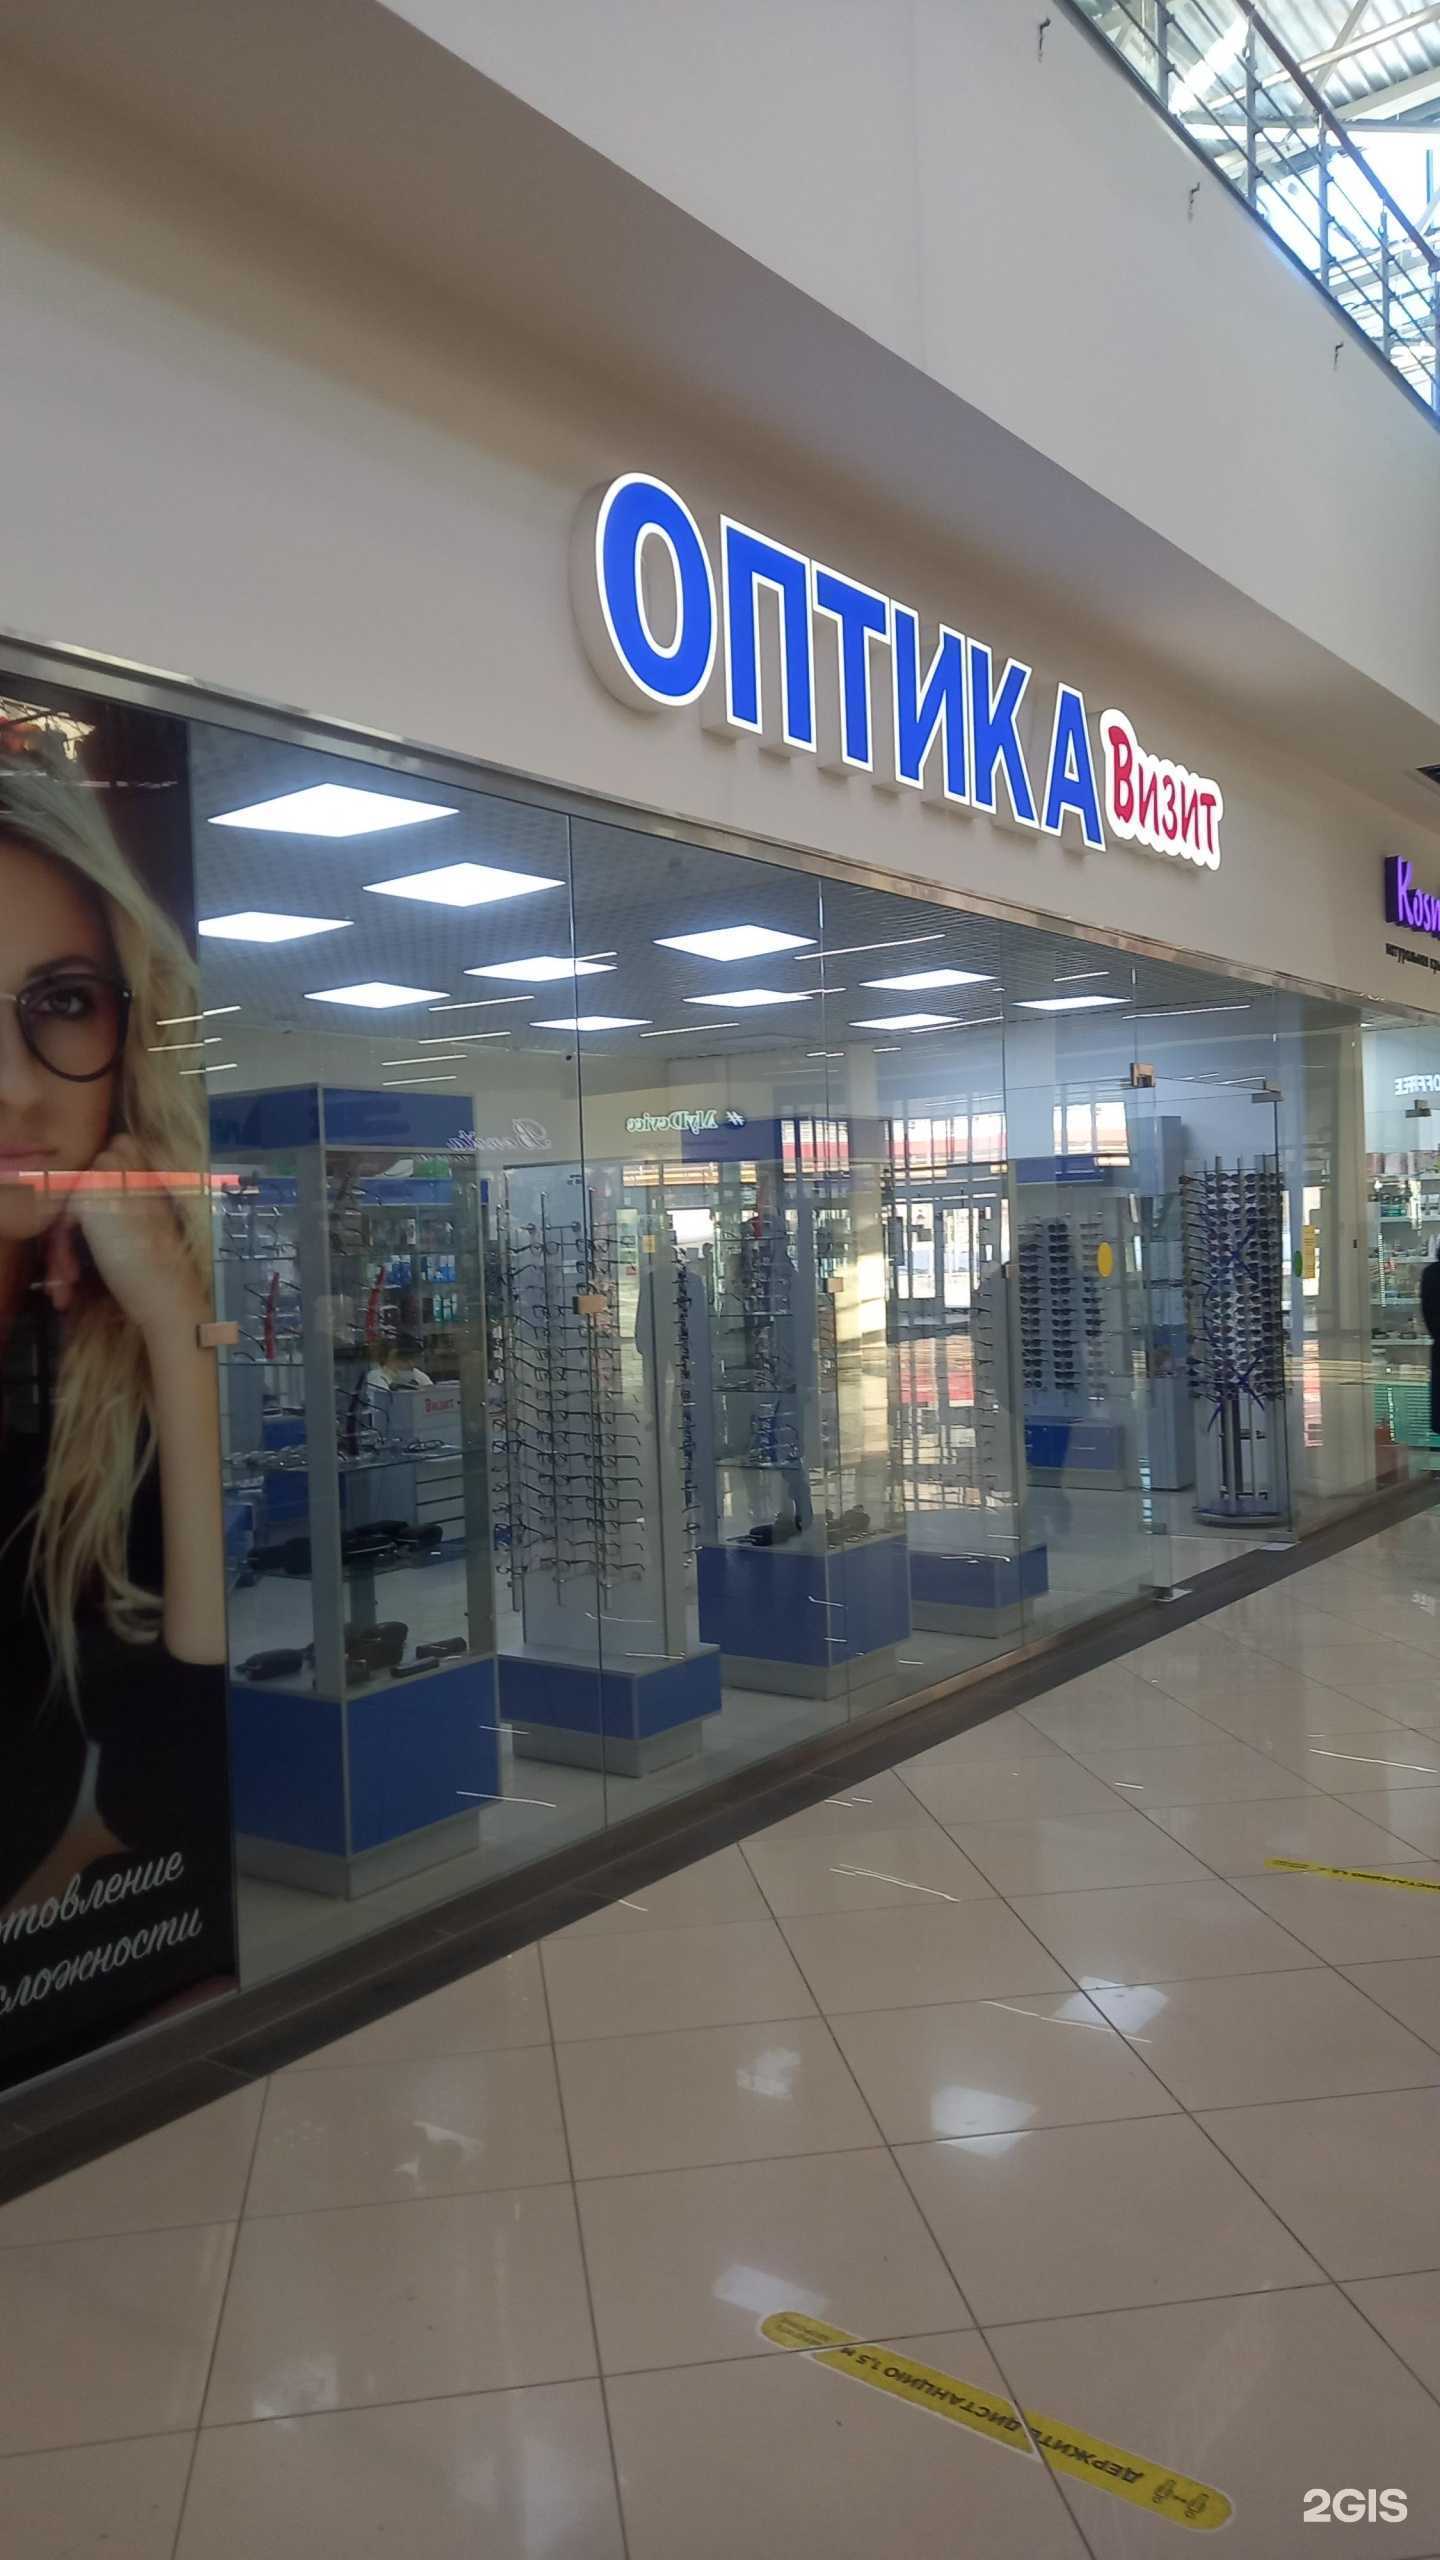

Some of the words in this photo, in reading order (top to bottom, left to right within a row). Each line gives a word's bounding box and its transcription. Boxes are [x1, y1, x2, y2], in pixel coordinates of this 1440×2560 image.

[596, 473, 1106, 851] ОПТИКА
[1106, 723, 1218, 857] Визит
[0, 1852, 185, 1944] товление
[856, 2353, 882, 2371] 1,5
[883, 2366, 1022, 2432] ДИСТАНЦИЮ
